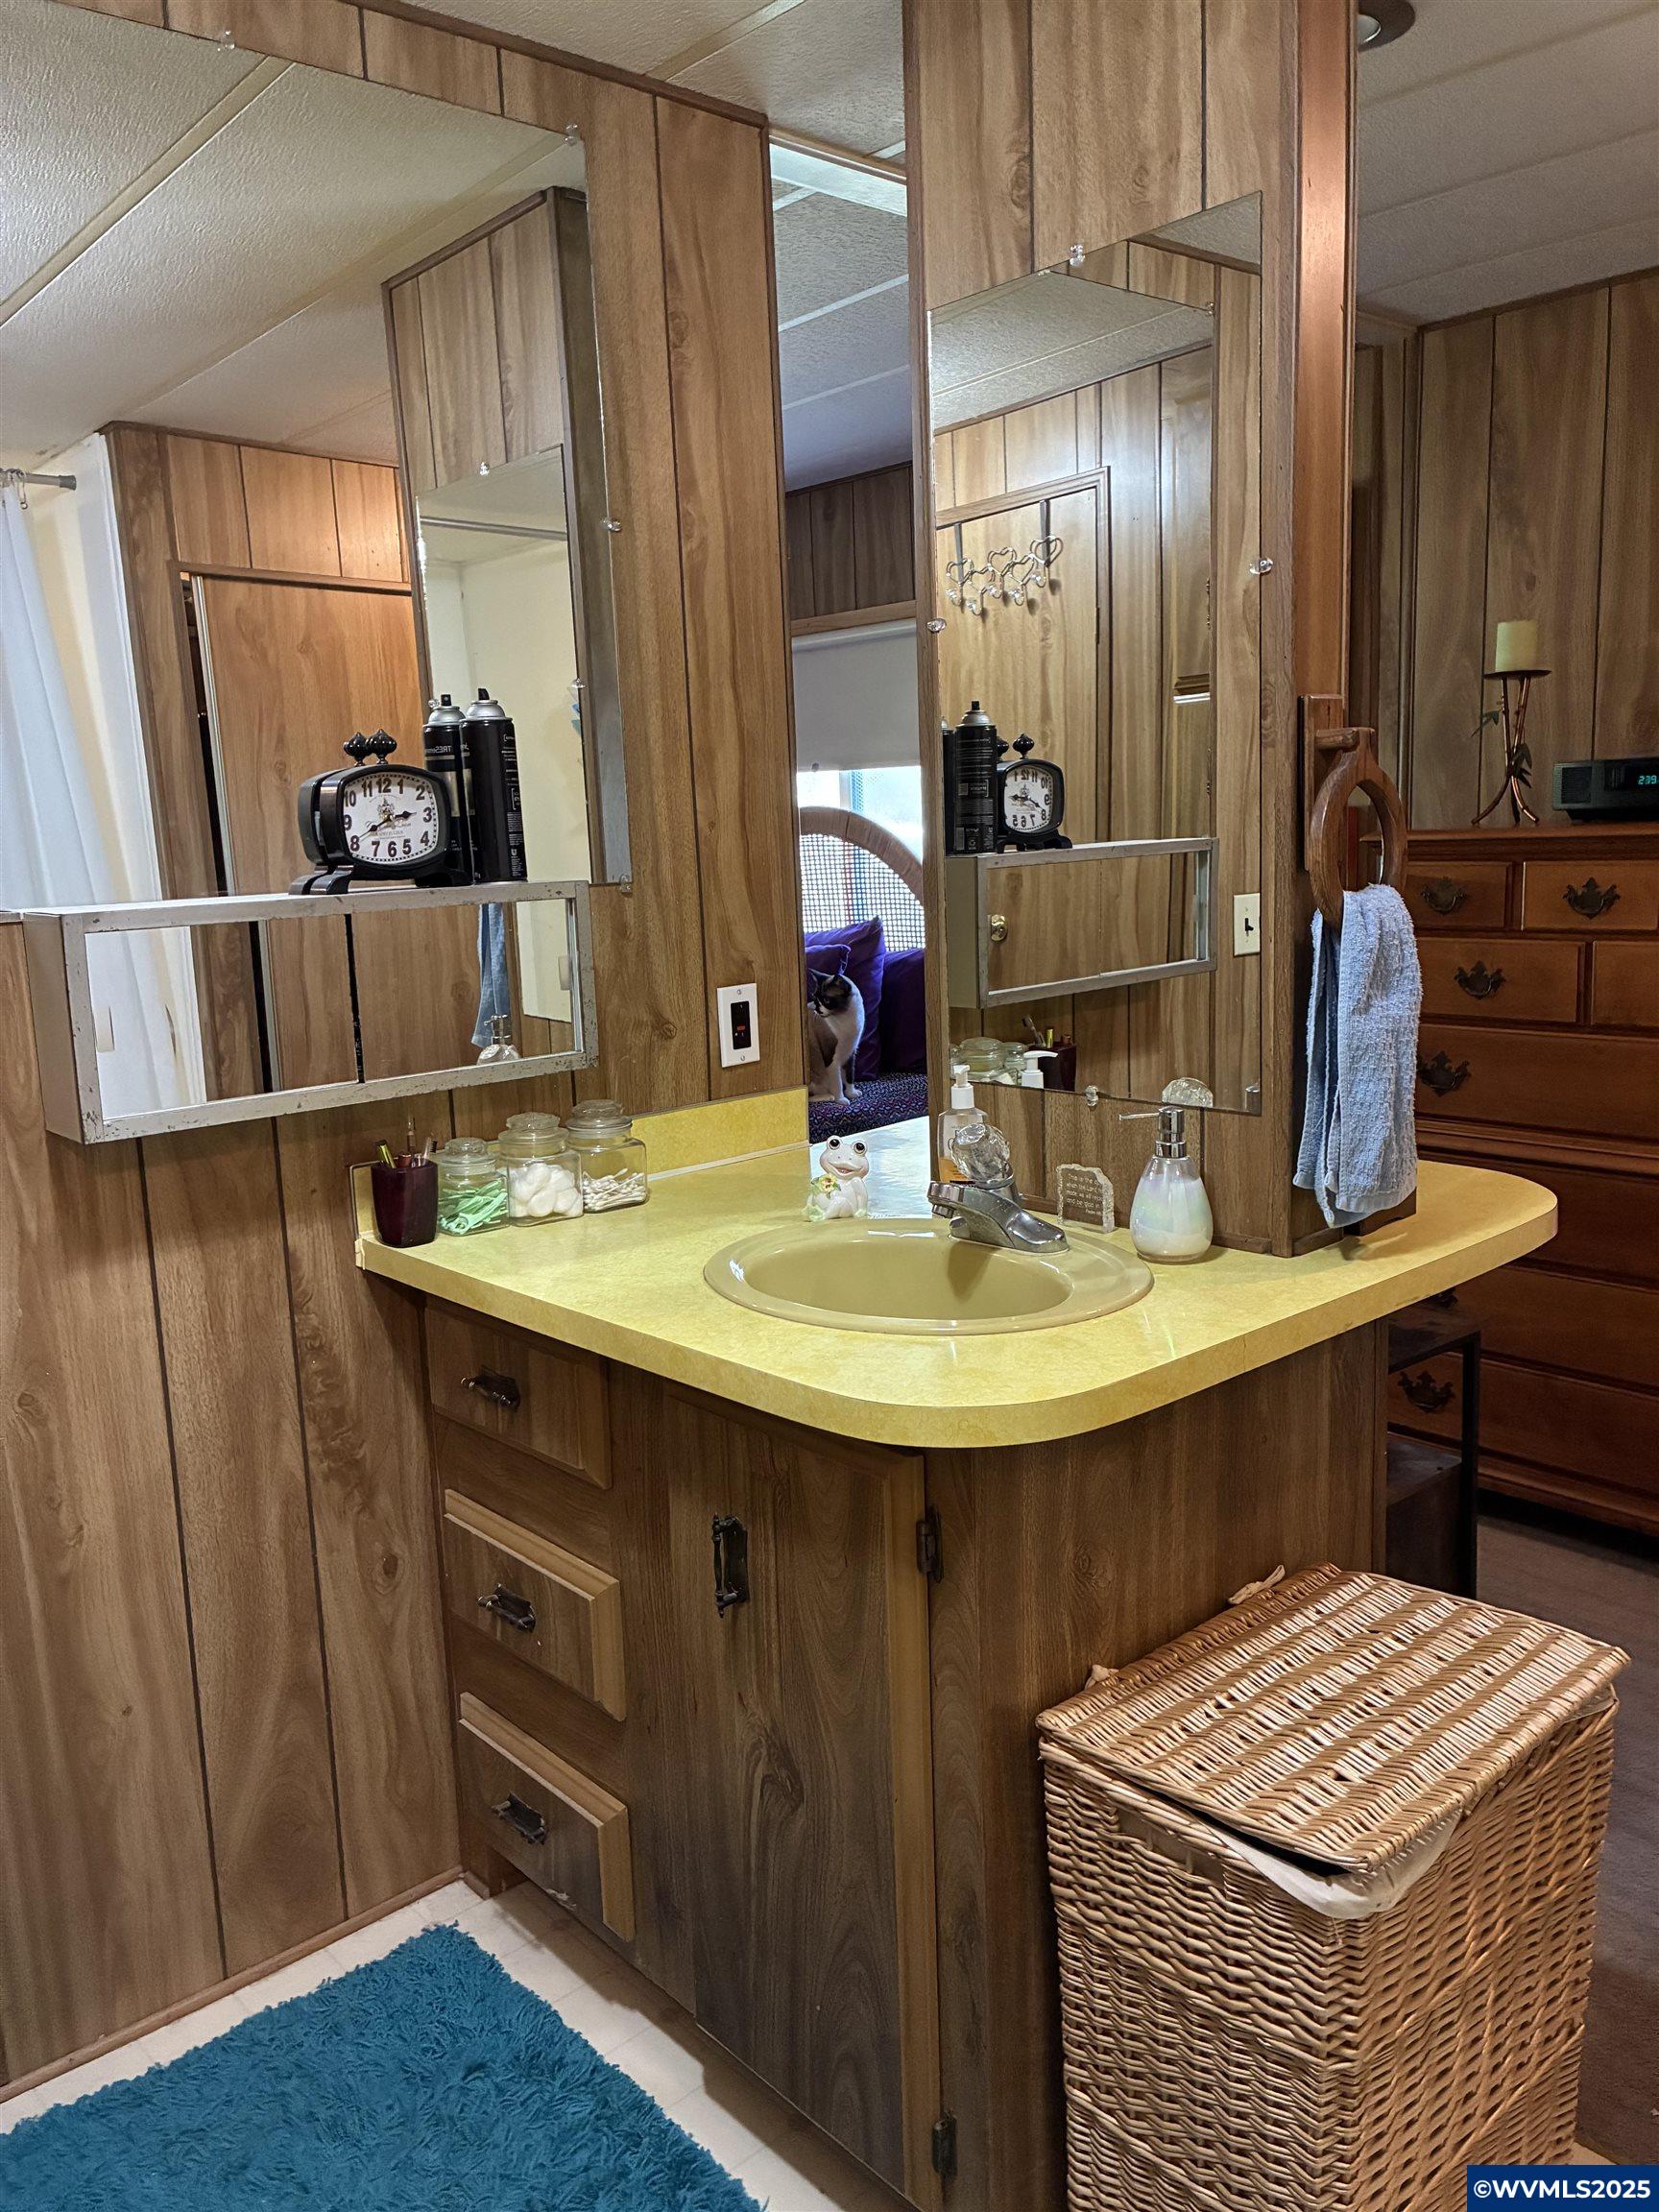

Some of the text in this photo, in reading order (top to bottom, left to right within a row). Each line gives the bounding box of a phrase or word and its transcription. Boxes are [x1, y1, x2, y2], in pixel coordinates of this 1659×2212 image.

[362, 781, 373, 797] 11
[376, 778, 392, 793] 12
[397, 778, 403, 794] 1
[416, 784, 424, 801] 2
[345, 789, 356, 806] 10
[344, 814, 351, 830] 9
[423, 806, 432, 823] 3
[350, 835, 360, 852] 8
[402, 839, 411, 854] 5
[421, 831, 430, 846] 4
[372, 841, 380, 857] 7
[388, 841, 397, 857] 6
